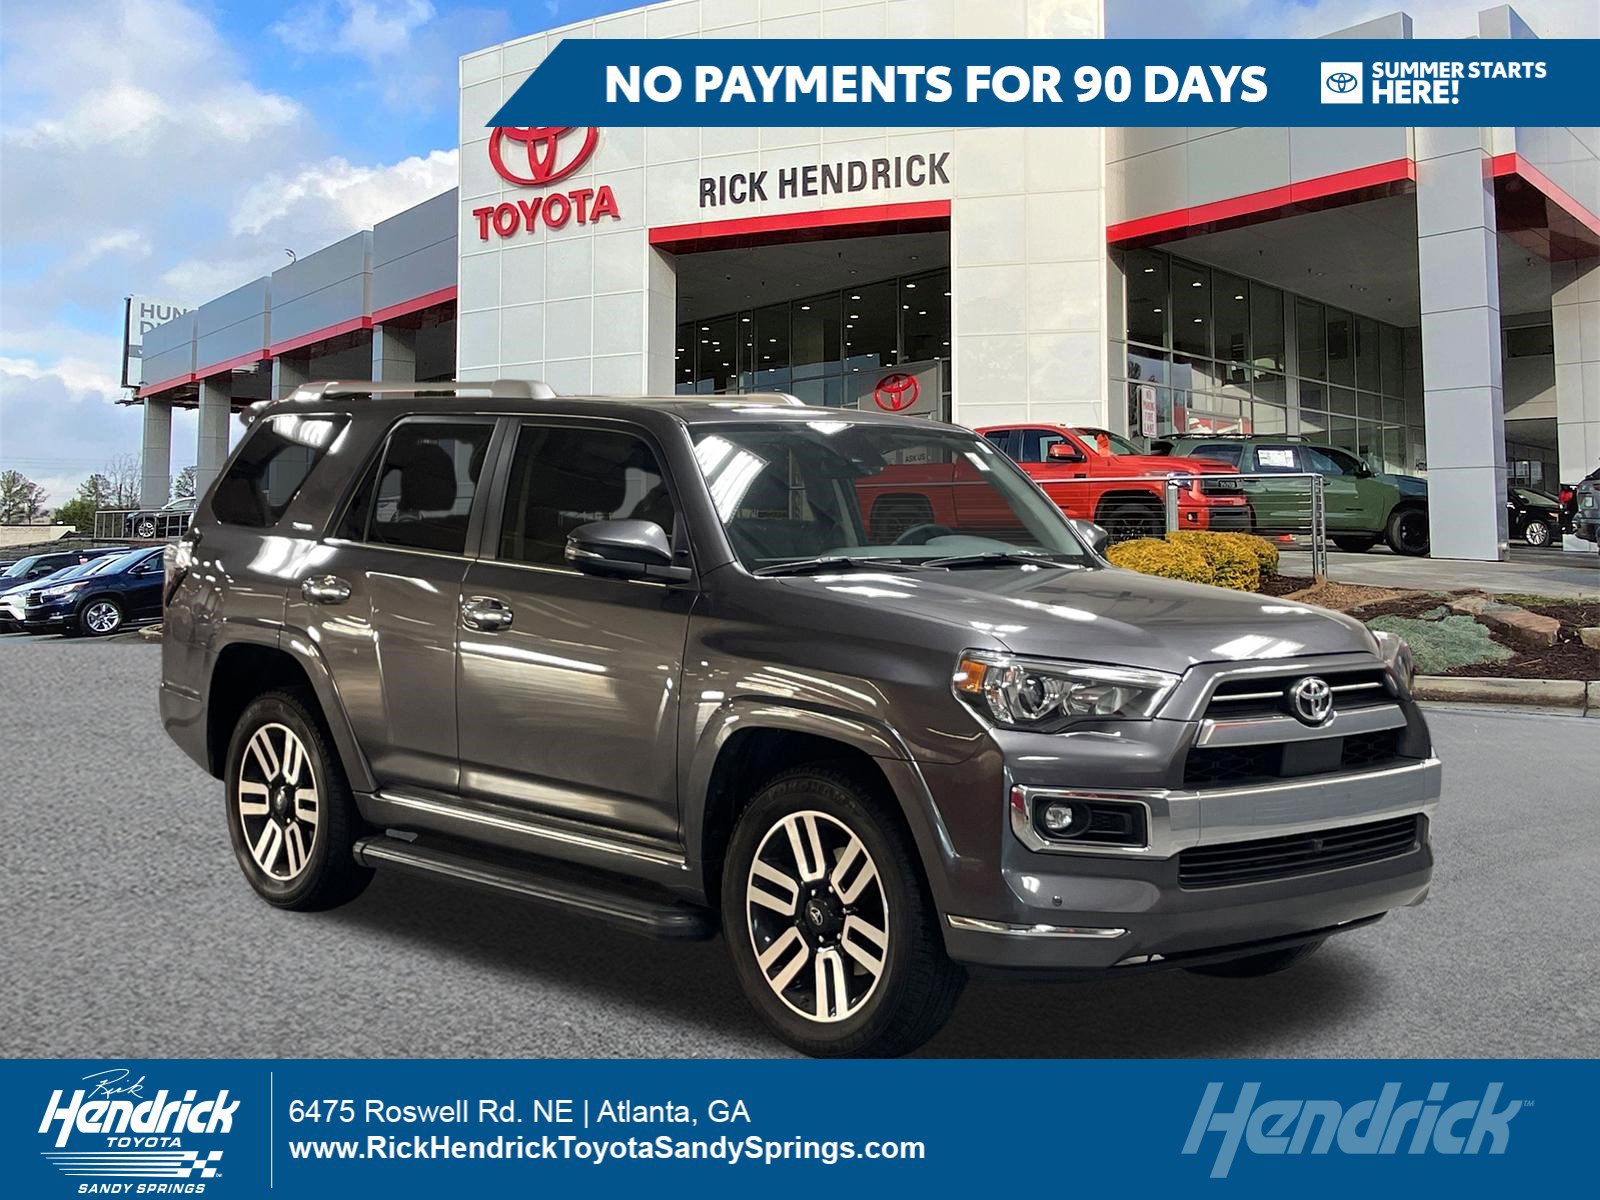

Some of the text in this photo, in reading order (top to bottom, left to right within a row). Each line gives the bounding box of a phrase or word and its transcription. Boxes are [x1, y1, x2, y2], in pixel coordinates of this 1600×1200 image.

[699, 152, 951, 208] RICK HENDRICK
[472, 185, 620, 241] TOYOTA
